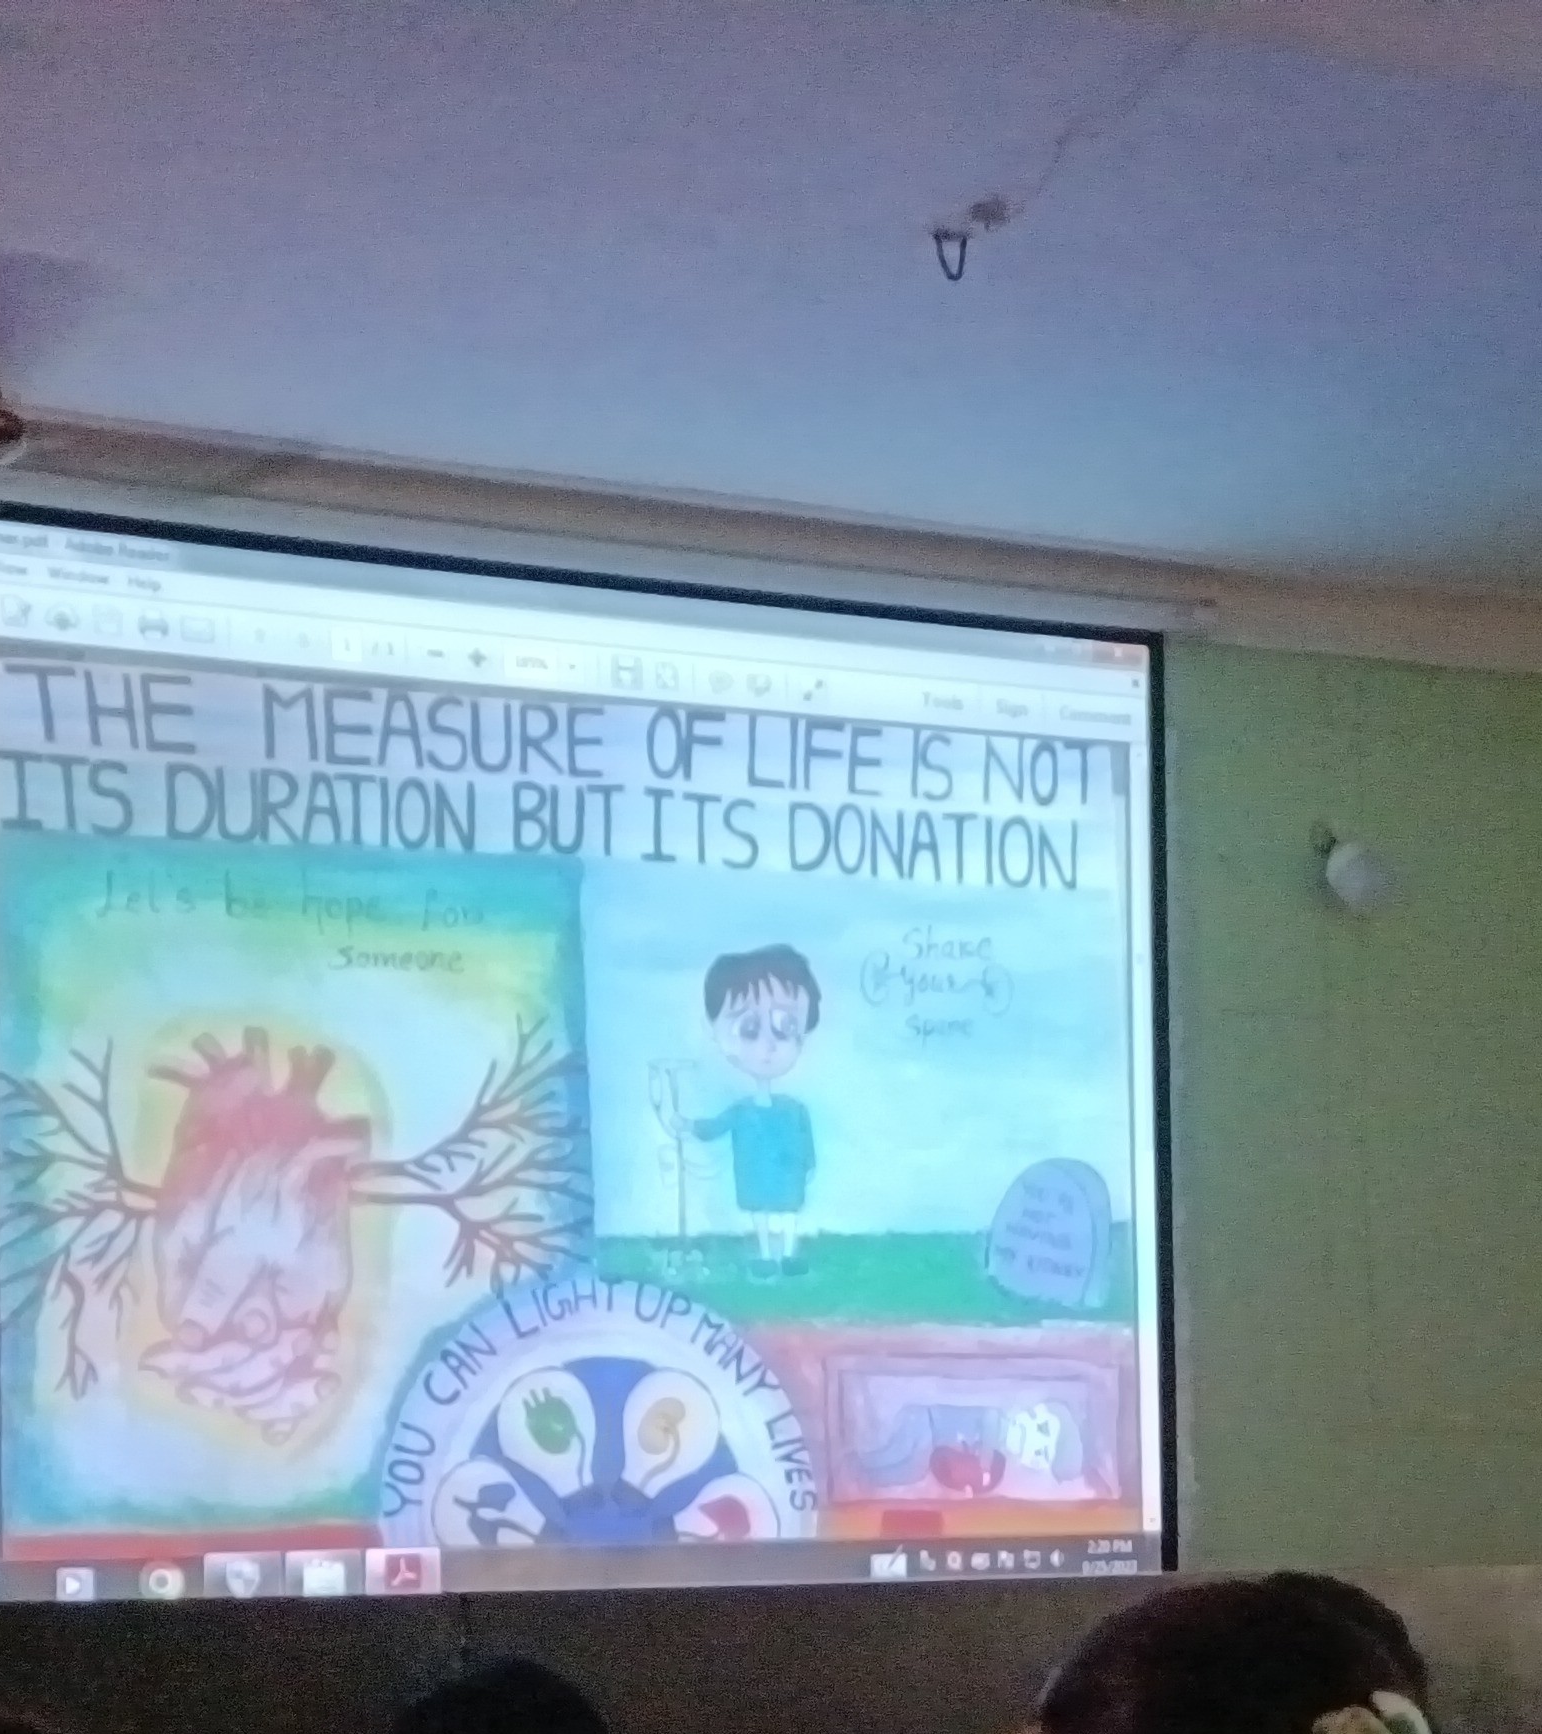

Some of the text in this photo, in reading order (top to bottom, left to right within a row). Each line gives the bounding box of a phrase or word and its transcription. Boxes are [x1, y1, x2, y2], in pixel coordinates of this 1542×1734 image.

[4, 662, 1090, 806] THE MEASURE OF LIFE IS NOT
[165, 761, 477, 854] DURATION
[512, 780, 625, 857] BUT
[641, 786, 760, 869] ITS
[788, 801, 1079, 891] DONATION
[382, 1279, 818, 1518] YOU CAN LIGHT UP MANY LIVES
